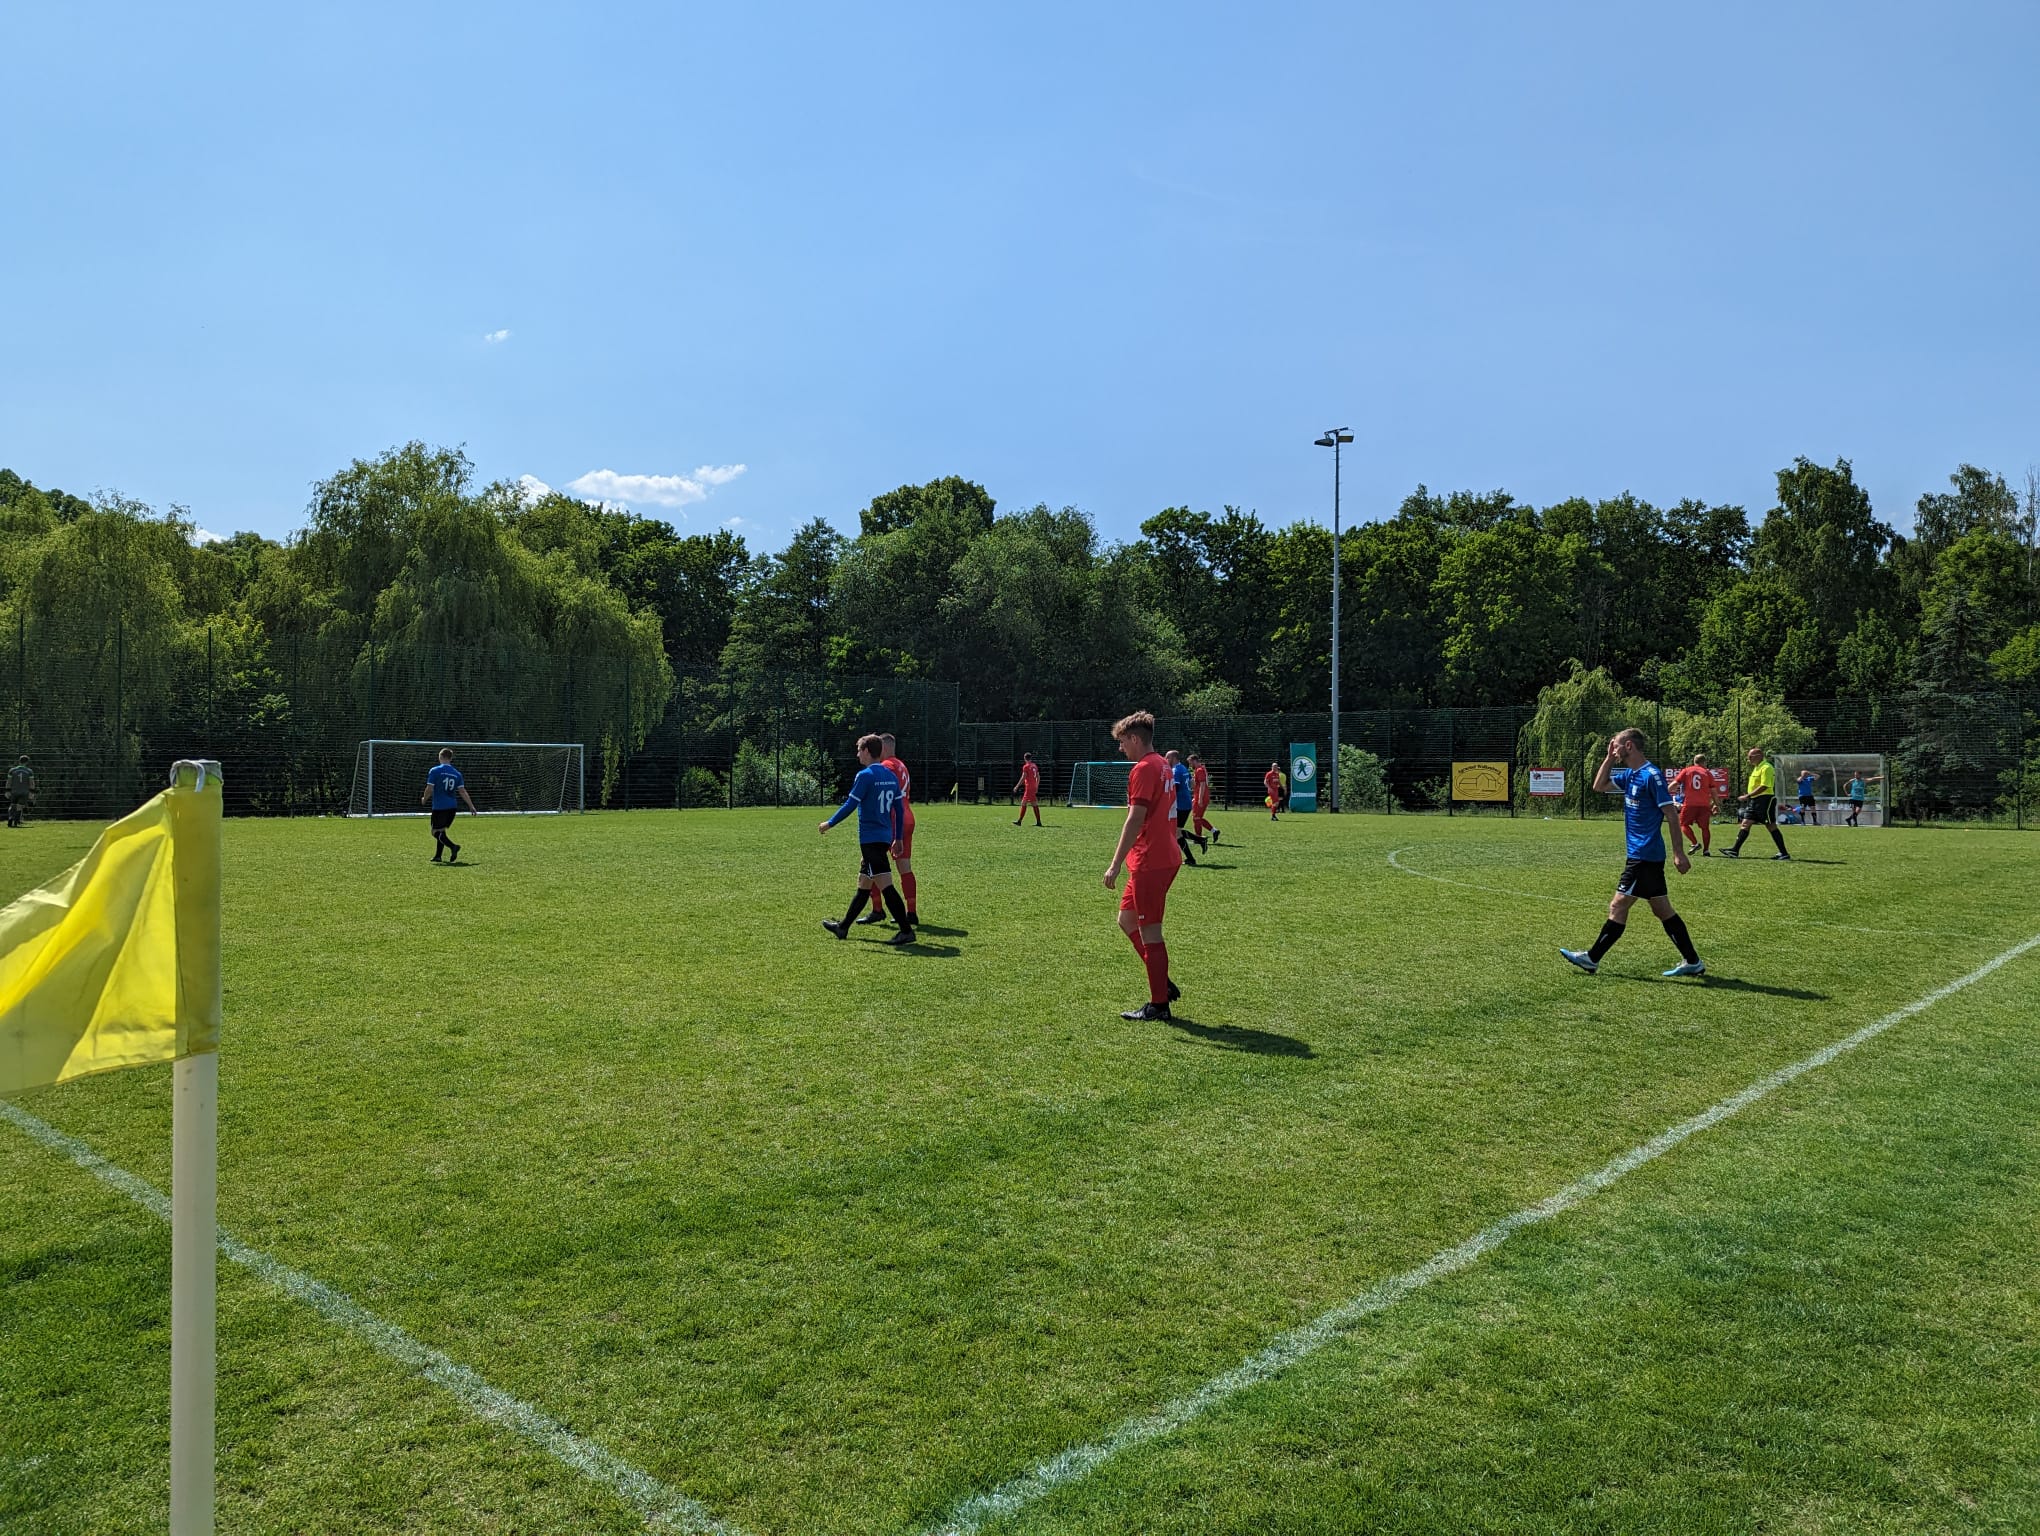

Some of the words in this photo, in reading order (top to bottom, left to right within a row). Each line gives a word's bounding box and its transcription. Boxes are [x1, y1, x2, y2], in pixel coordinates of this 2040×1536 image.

[442, 777, 455, 791] 19
[1692, 774, 1702, 790] 6
[878, 790, 894, 814] 18
